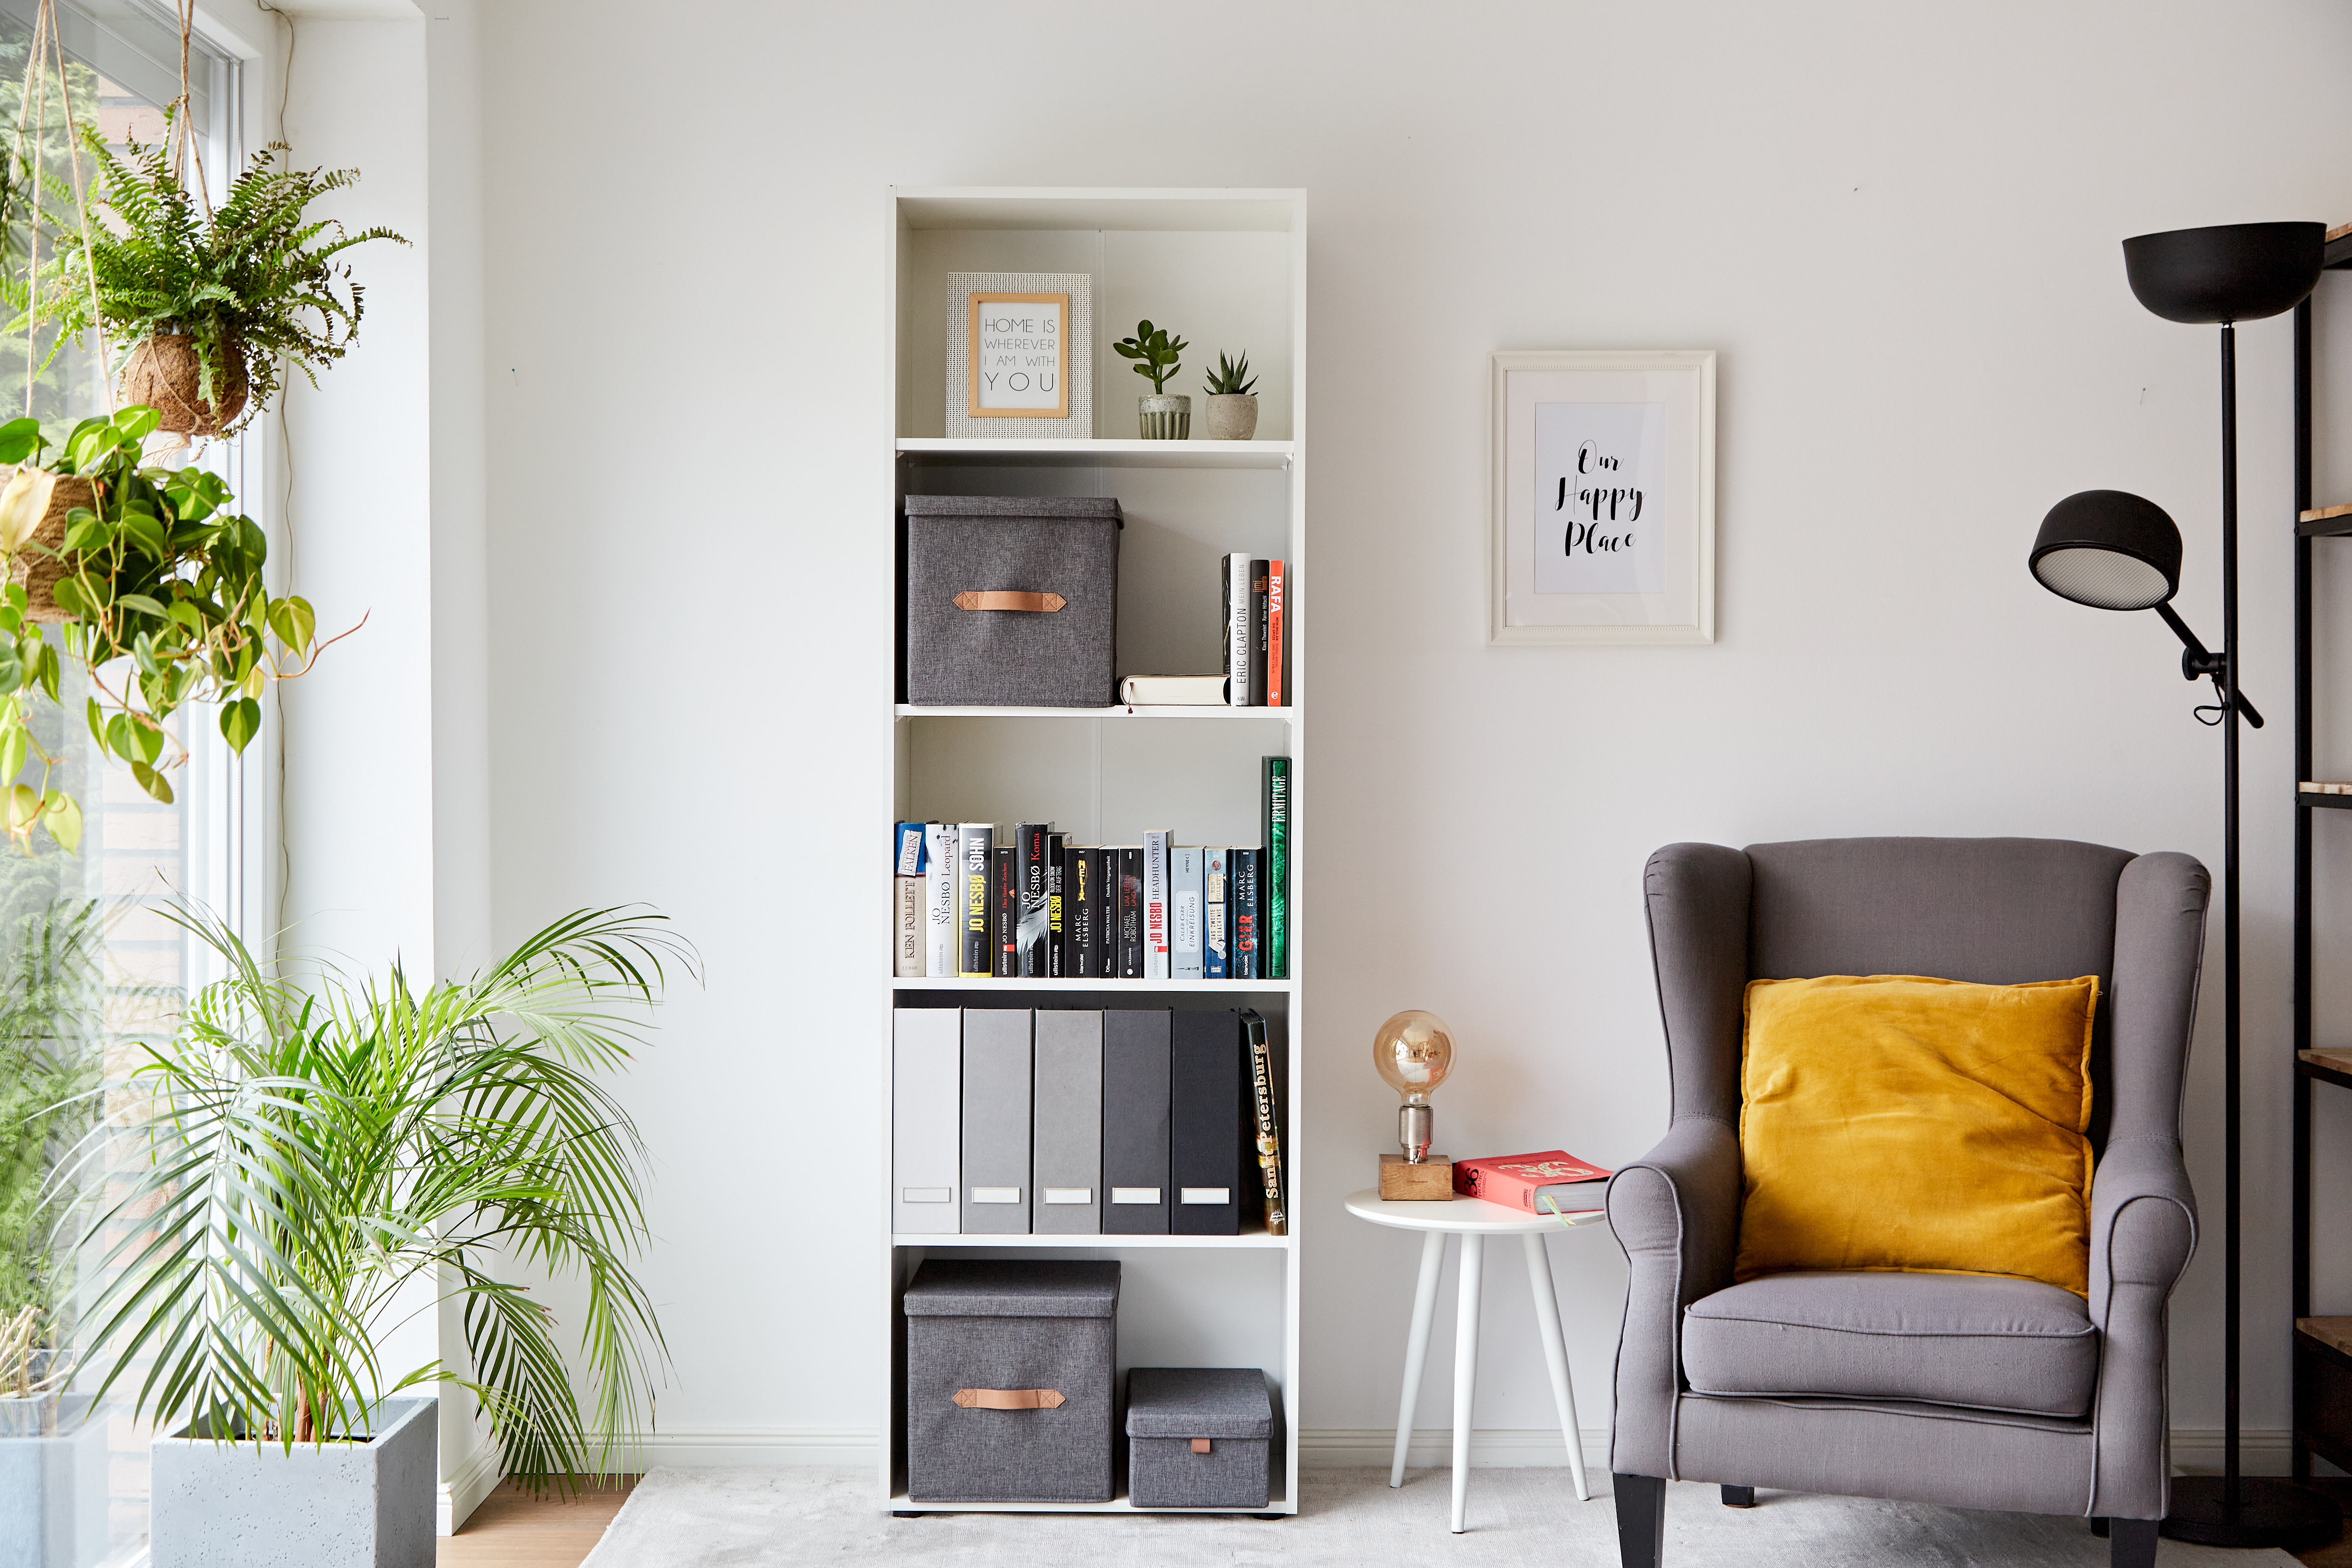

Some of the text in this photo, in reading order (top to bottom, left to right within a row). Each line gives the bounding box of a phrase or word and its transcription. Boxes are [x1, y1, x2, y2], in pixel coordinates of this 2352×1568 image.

[985, 319, 1055, 333] HOME IS
[985, 338, 1055, 350] WHEREVER
[984, 355, 1055, 366] I AM WITH
[985, 372, 1054, 392] YOU
[1578, 439, 1625, 474] Our
[1555, 474, 1647, 522] Happy
[1564, 521, 1637, 557] Place
[1271, 576, 1281, 613] RAFA
[1237, 608, 1246, 684] ERIC CLAPTON
[1272, 776, 1286, 822] ERMITAGE
[901, 834, 911, 870] MITTERNACHTS
[905, 835, 918, 872] FALKEN
[941, 835, 953, 876] Leopard
[1031, 833, 1040, 861] Koma
[941, 882, 951, 924] NESBØ
[968, 838, 986, 933] JO NESBØ SOHN
[1022, 892, 1031, 909] JO
[1031, 865, 1040, 909] NESBØ
[1124, 895, 1130, 907] UM
[905, 881, 915, 959] KEN FOLLETT
[932, 908, 941, 925] JO
[1050, 896, 1062, 933] JO NESBØ
[1148, 902, 1162, 944] JO NESBØ
[1002, 935, 1009, 944] JO
[1238, 915, 1254, 951] GIER
[1253, 1044, 1279, 1199] Sankt Petersburg
[1463, 1167, 1479, 1195] 36
[1498, 1161, 1594, 1178] 36
